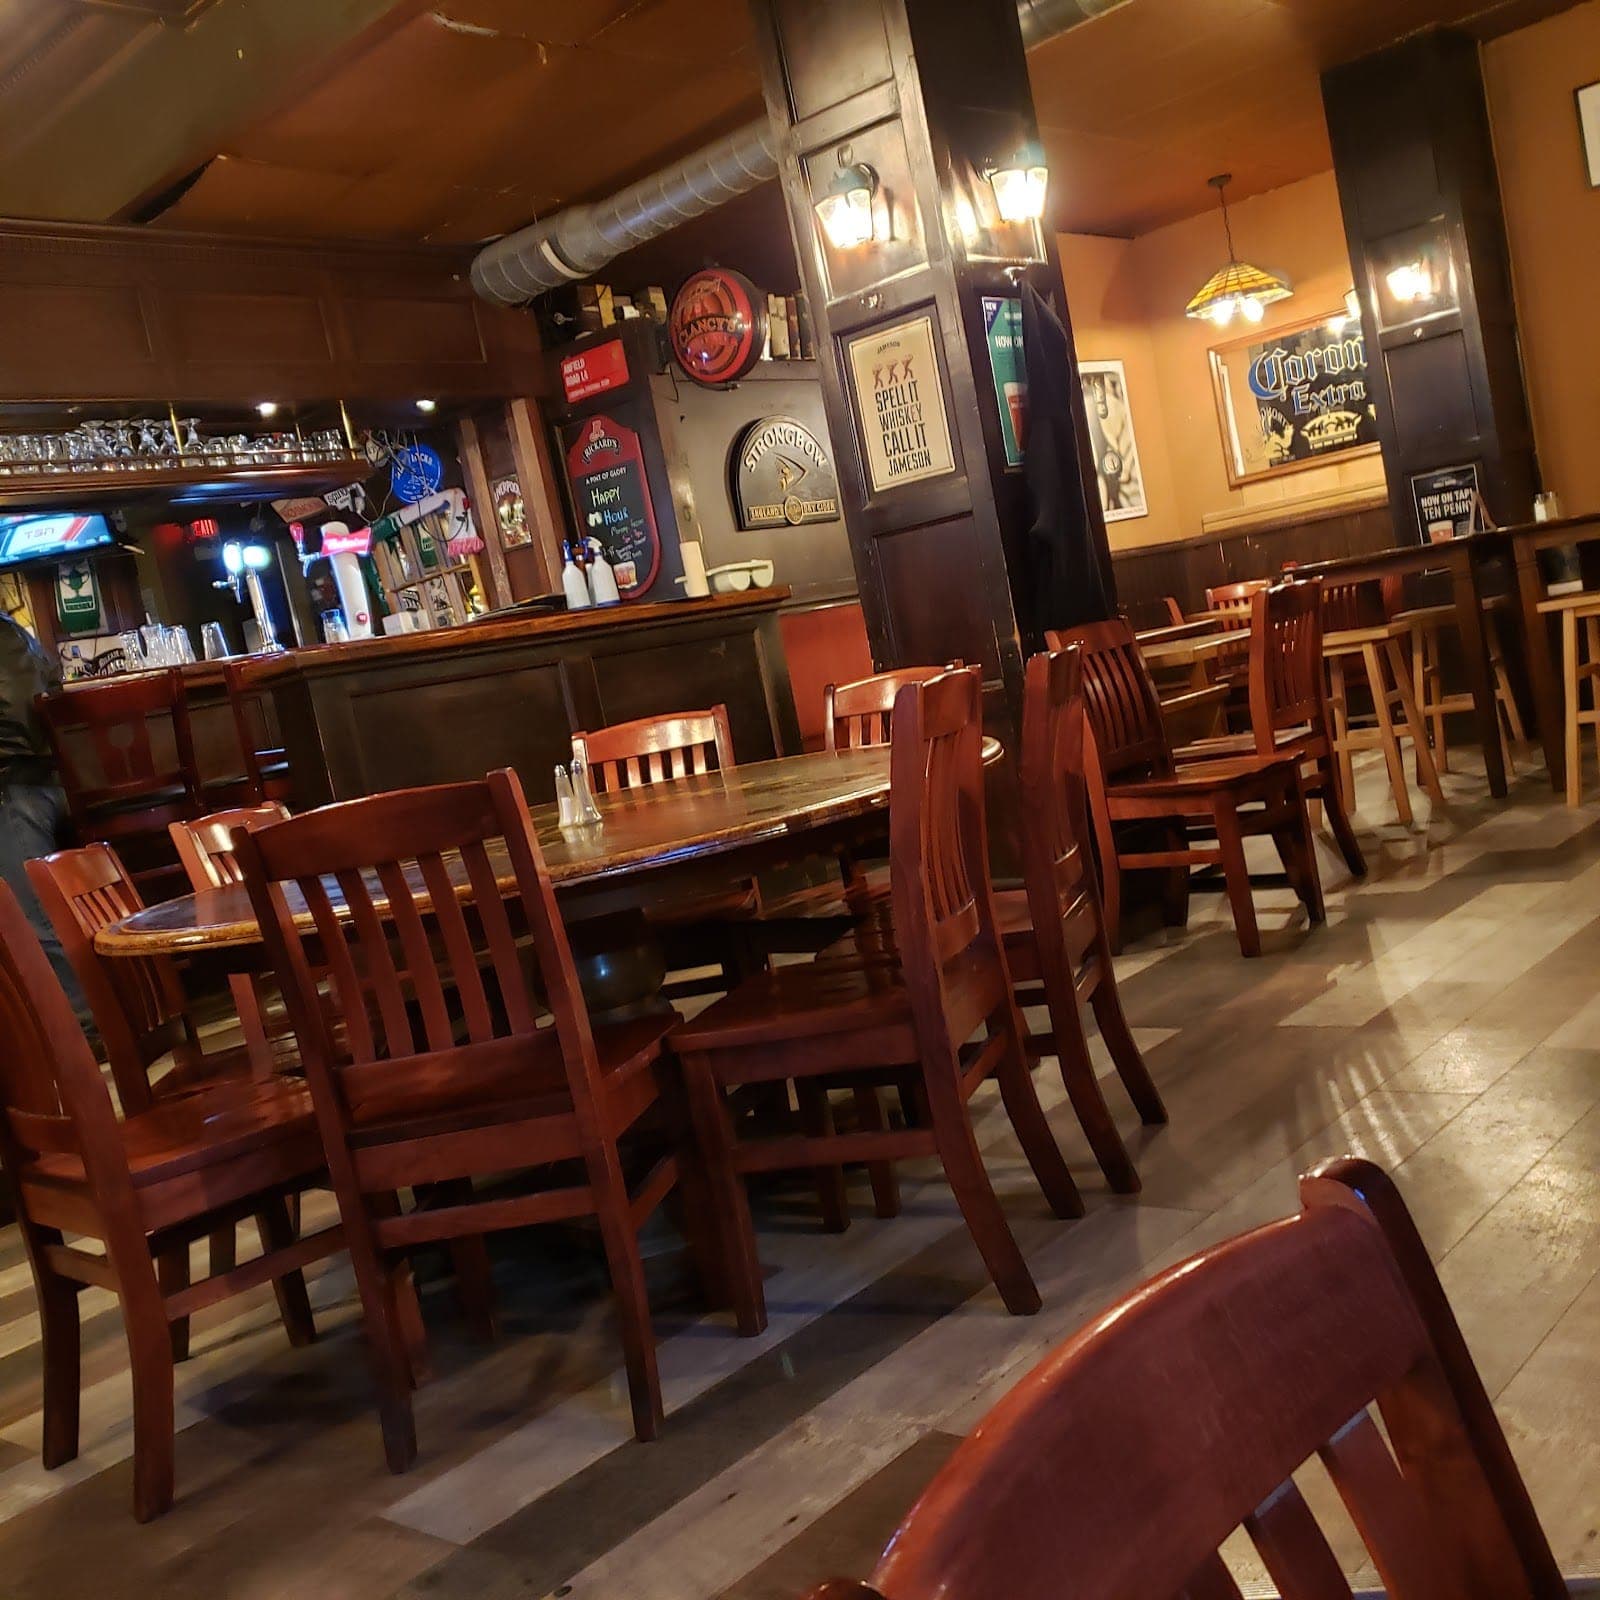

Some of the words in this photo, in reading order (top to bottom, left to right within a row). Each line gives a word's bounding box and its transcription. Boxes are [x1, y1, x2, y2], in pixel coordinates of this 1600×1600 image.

[877, 340, 901, 355] JAMESON
[994, 335, 1013, 348] NOW
[1247, 335, 1369, 402] Coron
[874, 383, 910, 413] SPELL
[909, 379, 921, 403] IT
[1291, 381, 1367, 416] Extra
[878, 403, 924, 433] WHISKEY
[584, 437, 618, 459] RICKARD'S
[745, 425, 828, 473] STRONGBOW
[882, 426, 915, 458] CALL
[914, 422, 928, 448] IT
[609, 466, 627, 478] GLORY
[888, 450, 932, 477] JAMESON
[1421, 494, 1440, 508] NOW
[1441, 491, 1453, 504] ON
[1423, 505, 1442, 520] TEN
